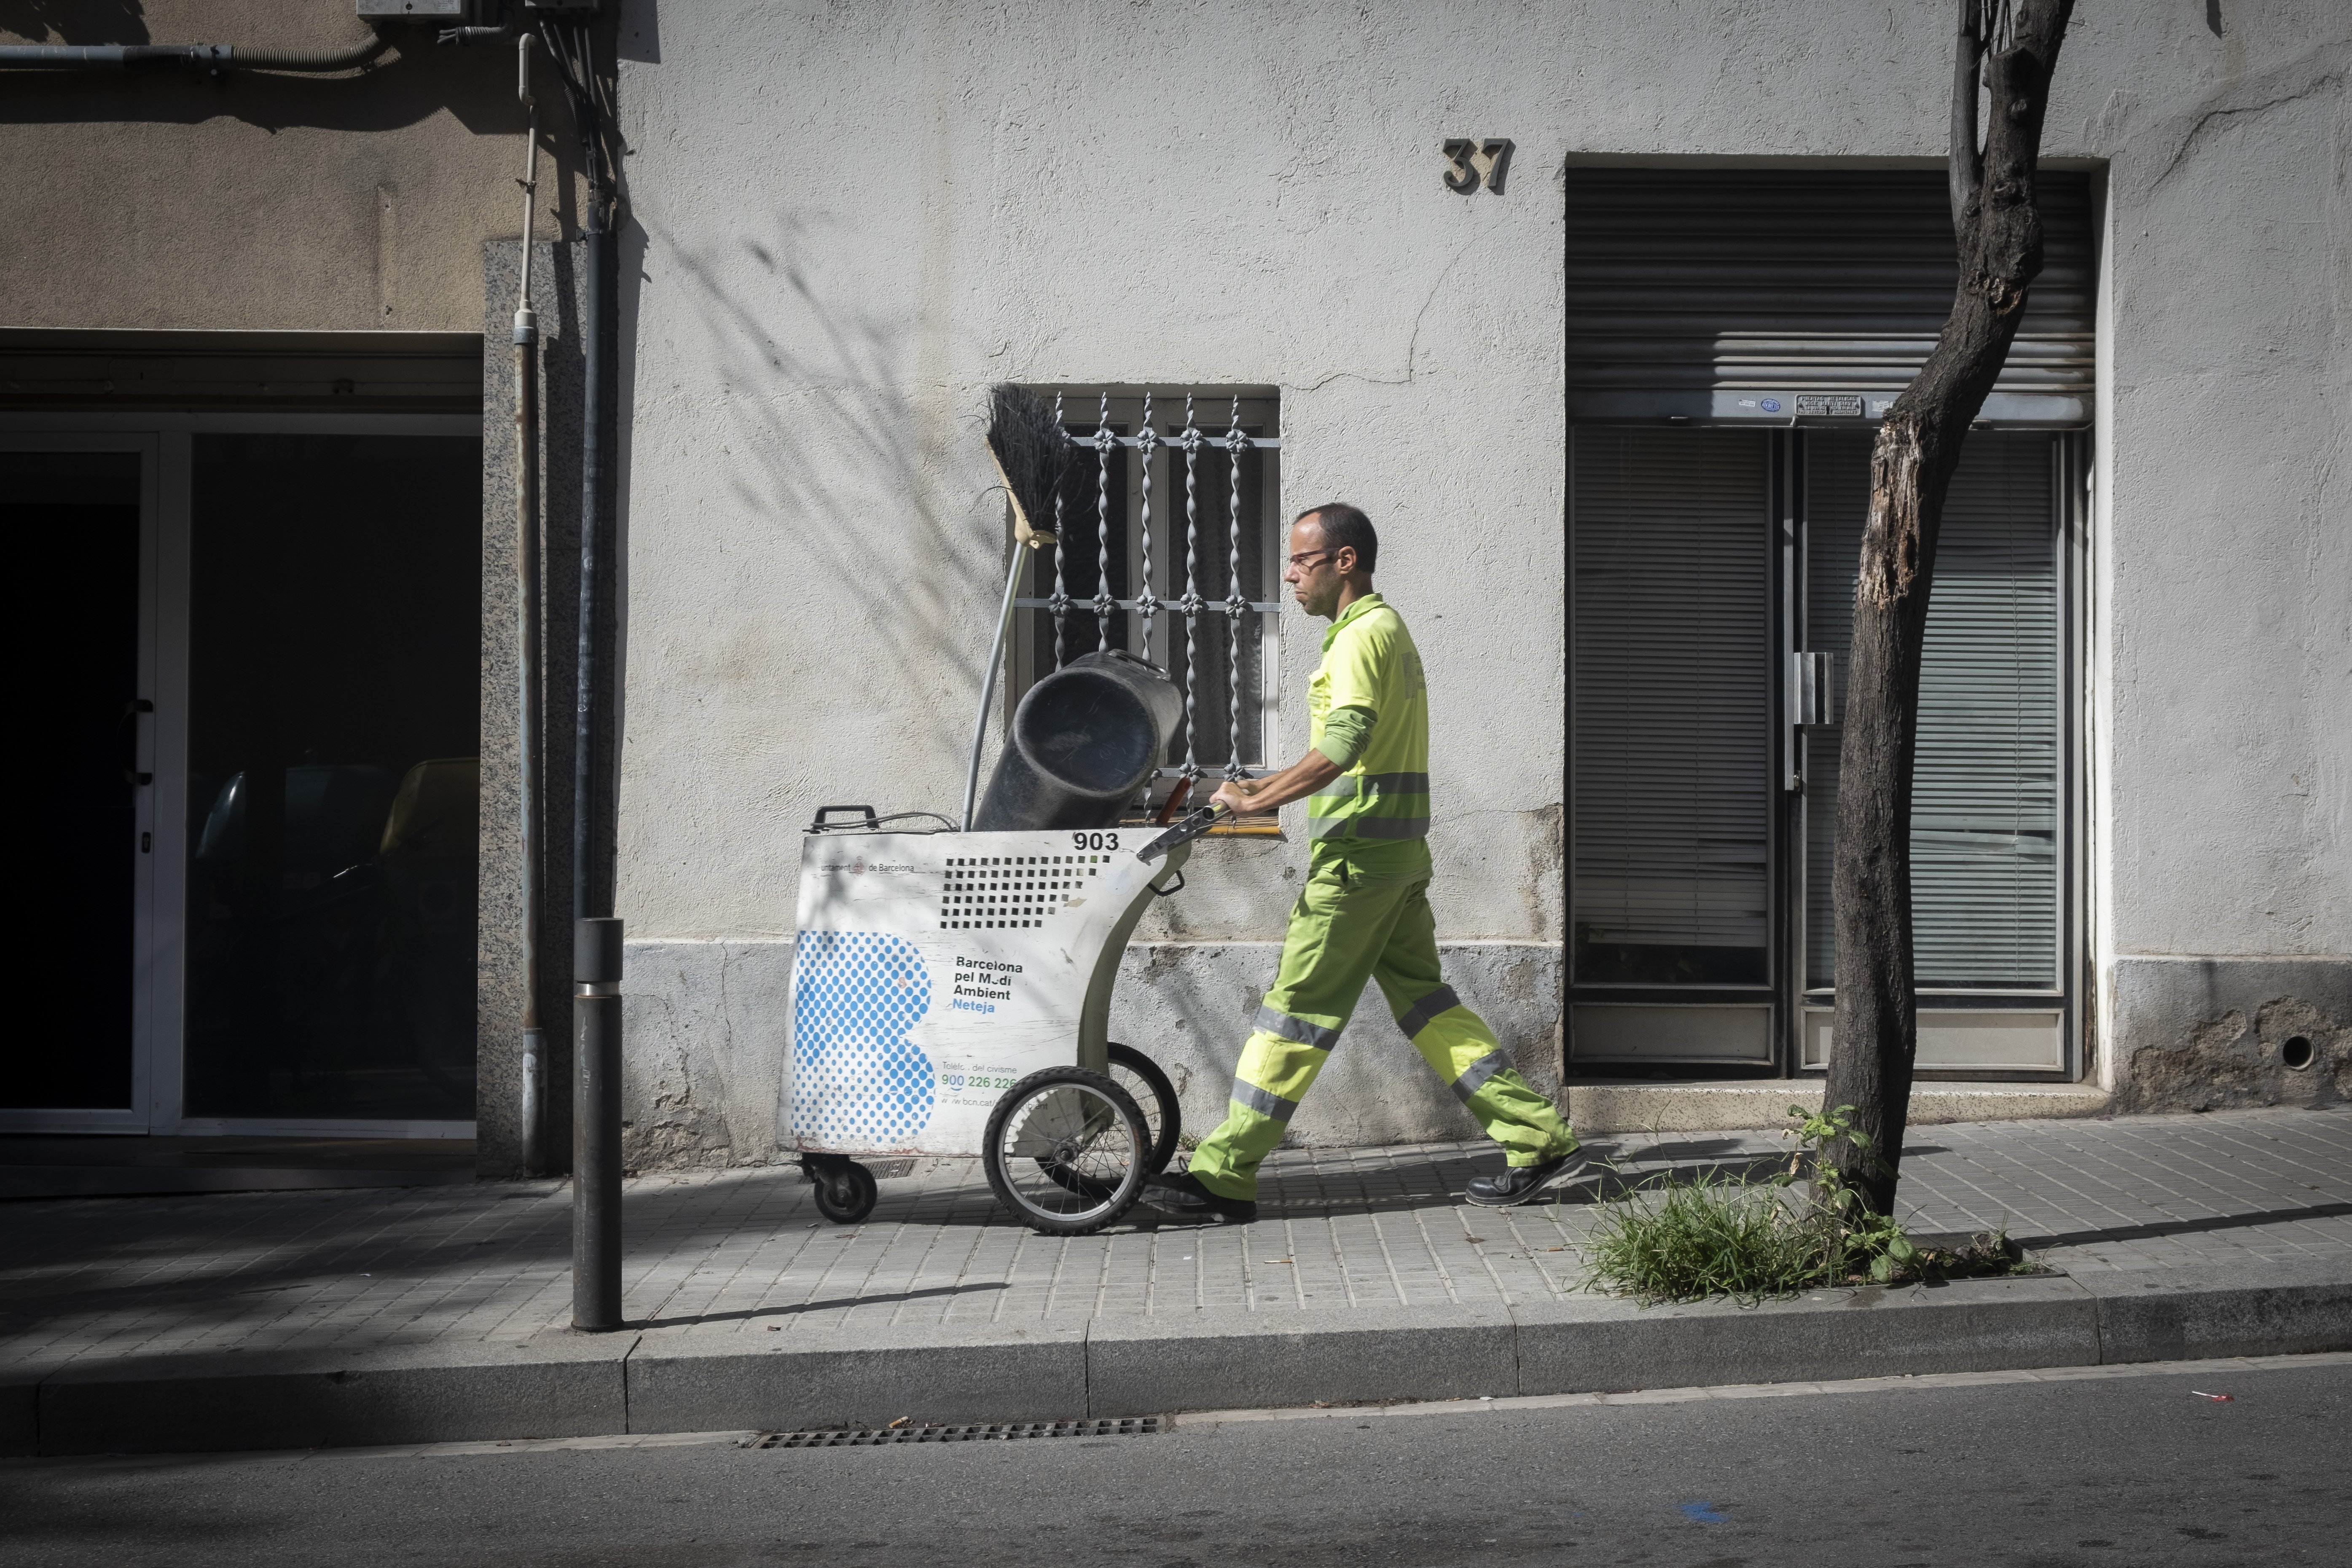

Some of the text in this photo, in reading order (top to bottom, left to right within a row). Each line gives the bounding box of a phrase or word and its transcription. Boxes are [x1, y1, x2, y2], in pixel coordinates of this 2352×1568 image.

[1443, 138, 1515, 188] 37
[1074, 832, 1119, 851] 903
[956, 956, 1023, 973] Barcelona
[954, 972, 975, 983] pel
[953, 985, 1011, 1000] Ambient
[953, 998, 995, 1014] Neteja
[987, 1065, 1017, 1074] civisme
[942, 1074, 964, 1086] 900
[969, 1076, 990, 1088] 226
